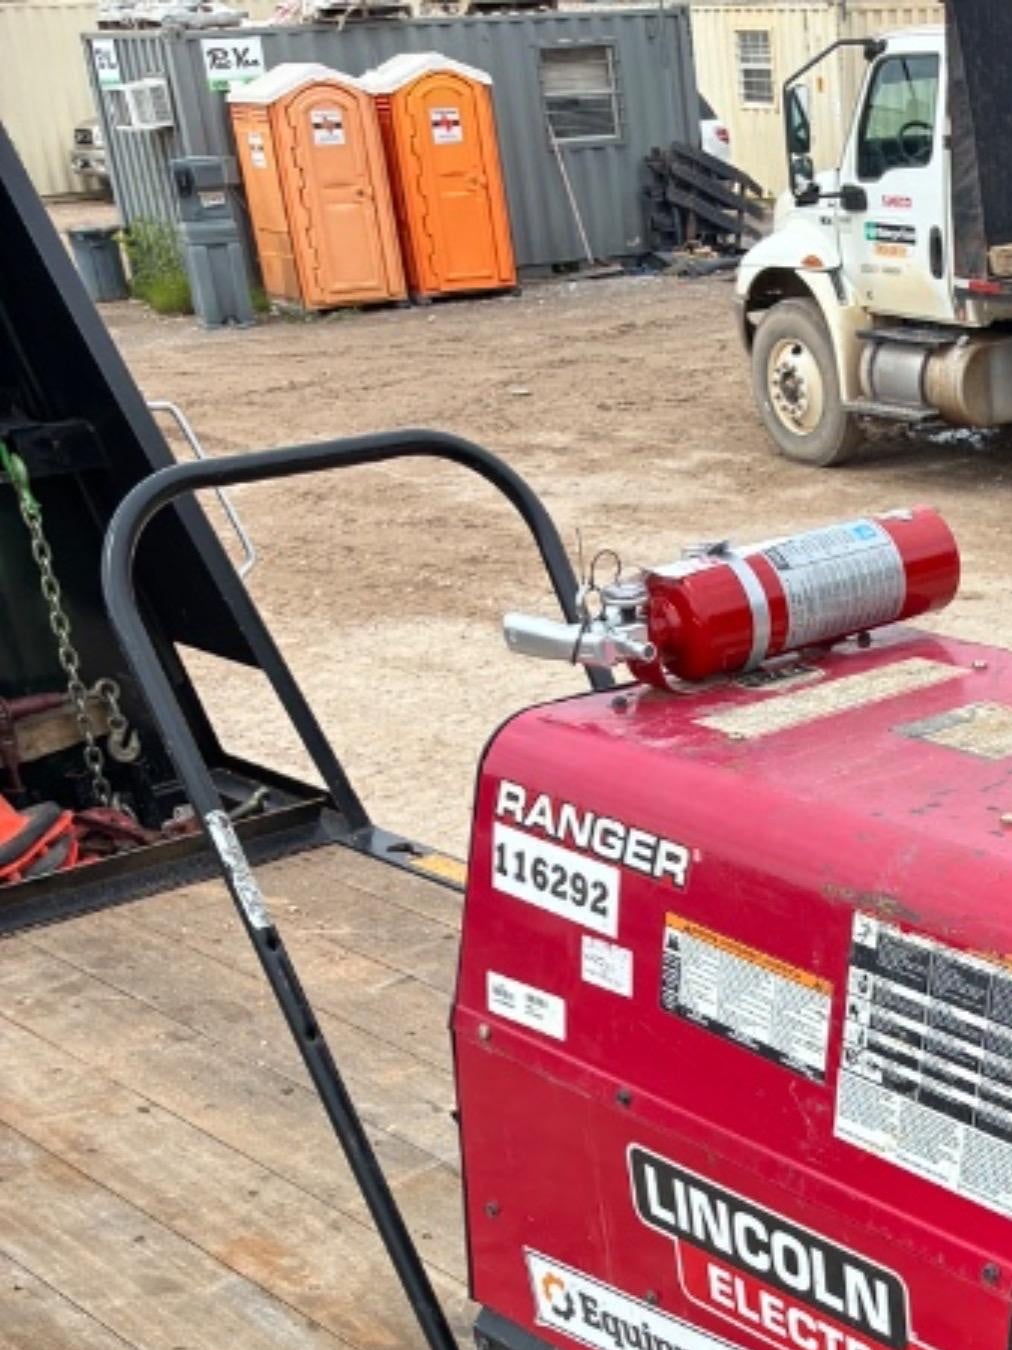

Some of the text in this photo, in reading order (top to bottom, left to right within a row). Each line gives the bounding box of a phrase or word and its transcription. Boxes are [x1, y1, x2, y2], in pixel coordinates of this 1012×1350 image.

[494, 842, 609, 917] 116292
[496, 778, 690, 887] RANGER
[643, 1162, 893, 1337] LINCOLN
